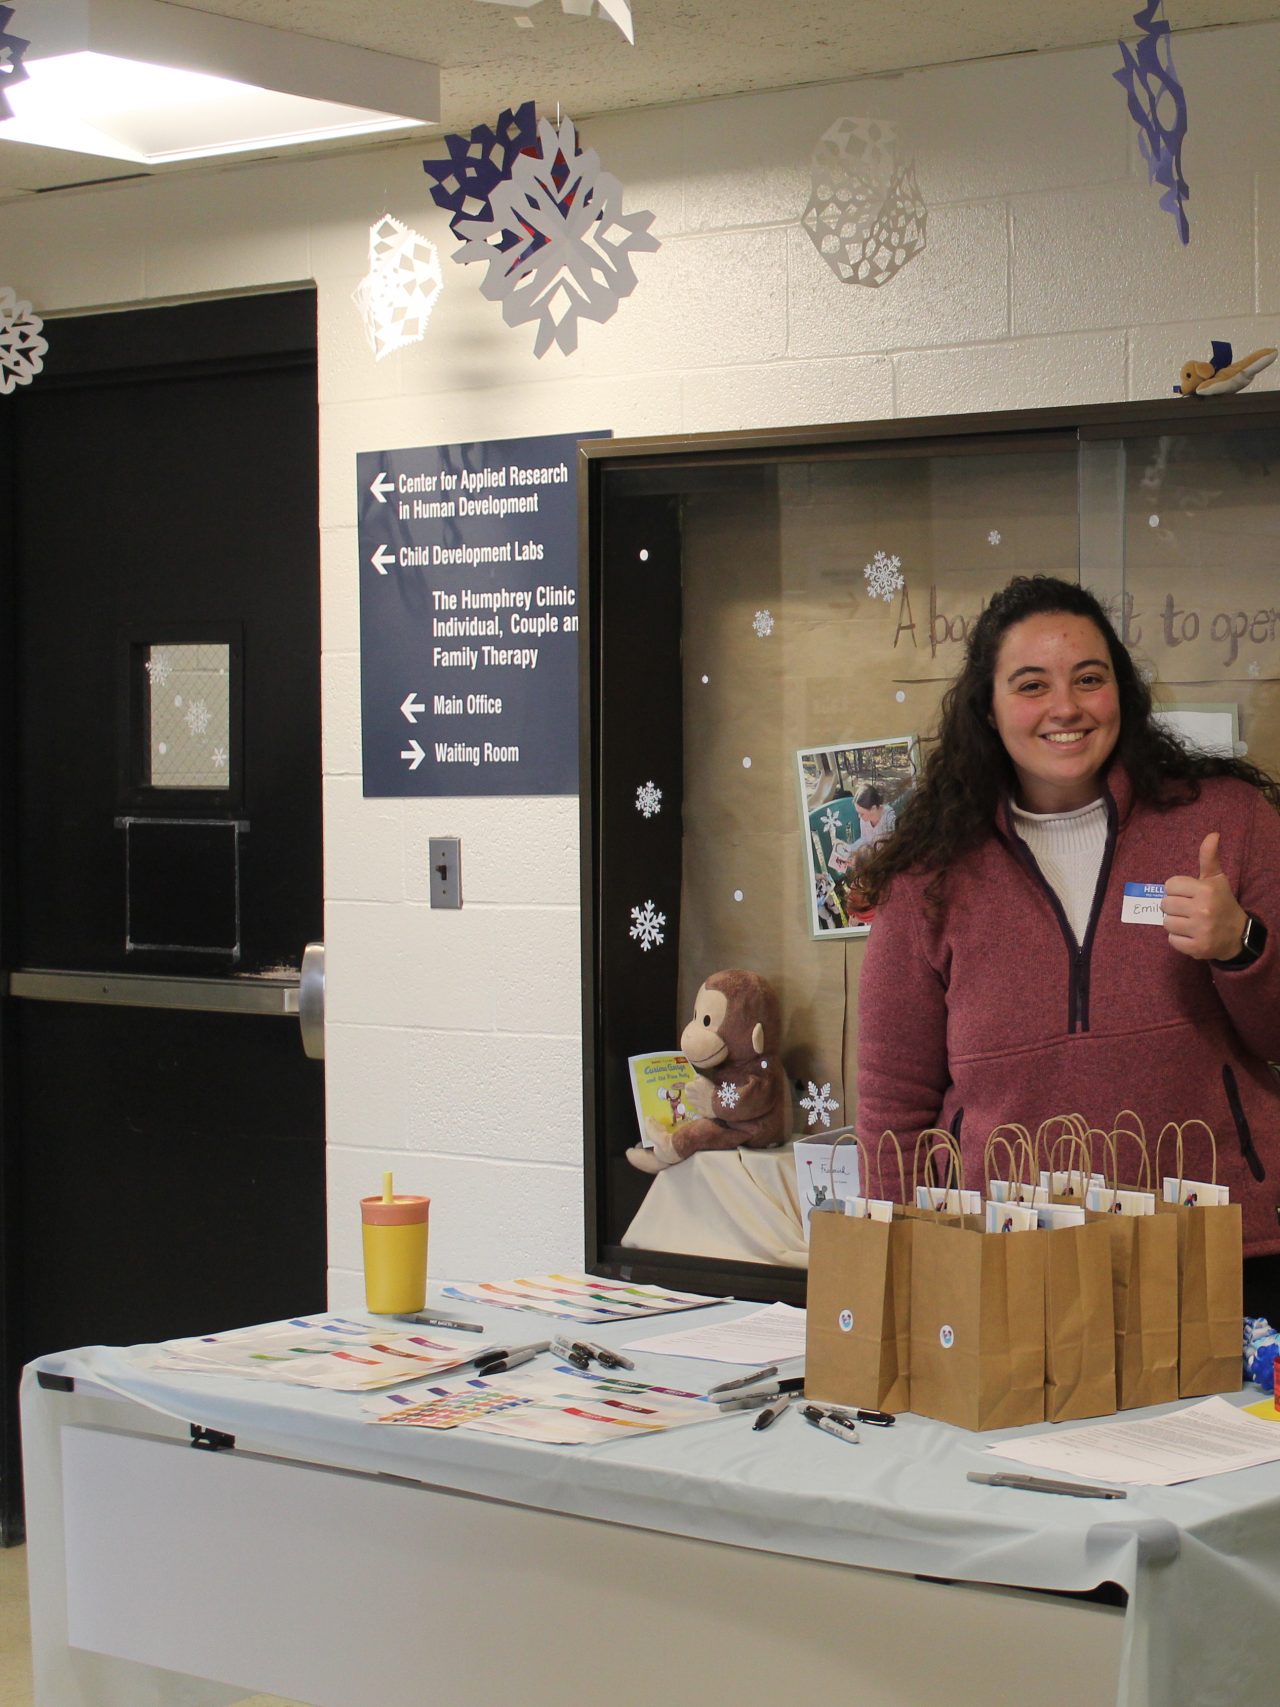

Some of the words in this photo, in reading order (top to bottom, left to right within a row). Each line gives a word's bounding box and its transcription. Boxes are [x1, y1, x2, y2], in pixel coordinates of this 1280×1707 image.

[399, 472, 437, 494] Center
[440, 472, 457, 490] for
[461, 467, 506, 492] Applied
[510, 463, 568, 486] Research
[399, 501, 410, 520] in
[413, 498, 455, 519] Human
[459, 493, 539, 519] Development
[399, 545, 430, 567] Child
[433, 542, 511, 568] Development
[514, 541, 544, 562] Labs
[433, 590, 457, 610] The
[461, 588, 532, 612] Humphrey
[536, 585, 576, 606] Clinic
[433, 616, 504, 639] Individual,
[511, 613, 558, 637] Couple
[563, 615, 579, 632] an
[894, 584, 917, 649] A
[1160, 592, 1200, 648] to
[433, 648, 478, 670] Family
[481, 646, 539, 669] Therapy
[433, 695, 464, 715] Main
[466, 694, 502, 715] Office
[435, 743, 480, 766] Waiting
[484, 742, 519, 763] Room
[1143, 885, 1165, 894] HELL
